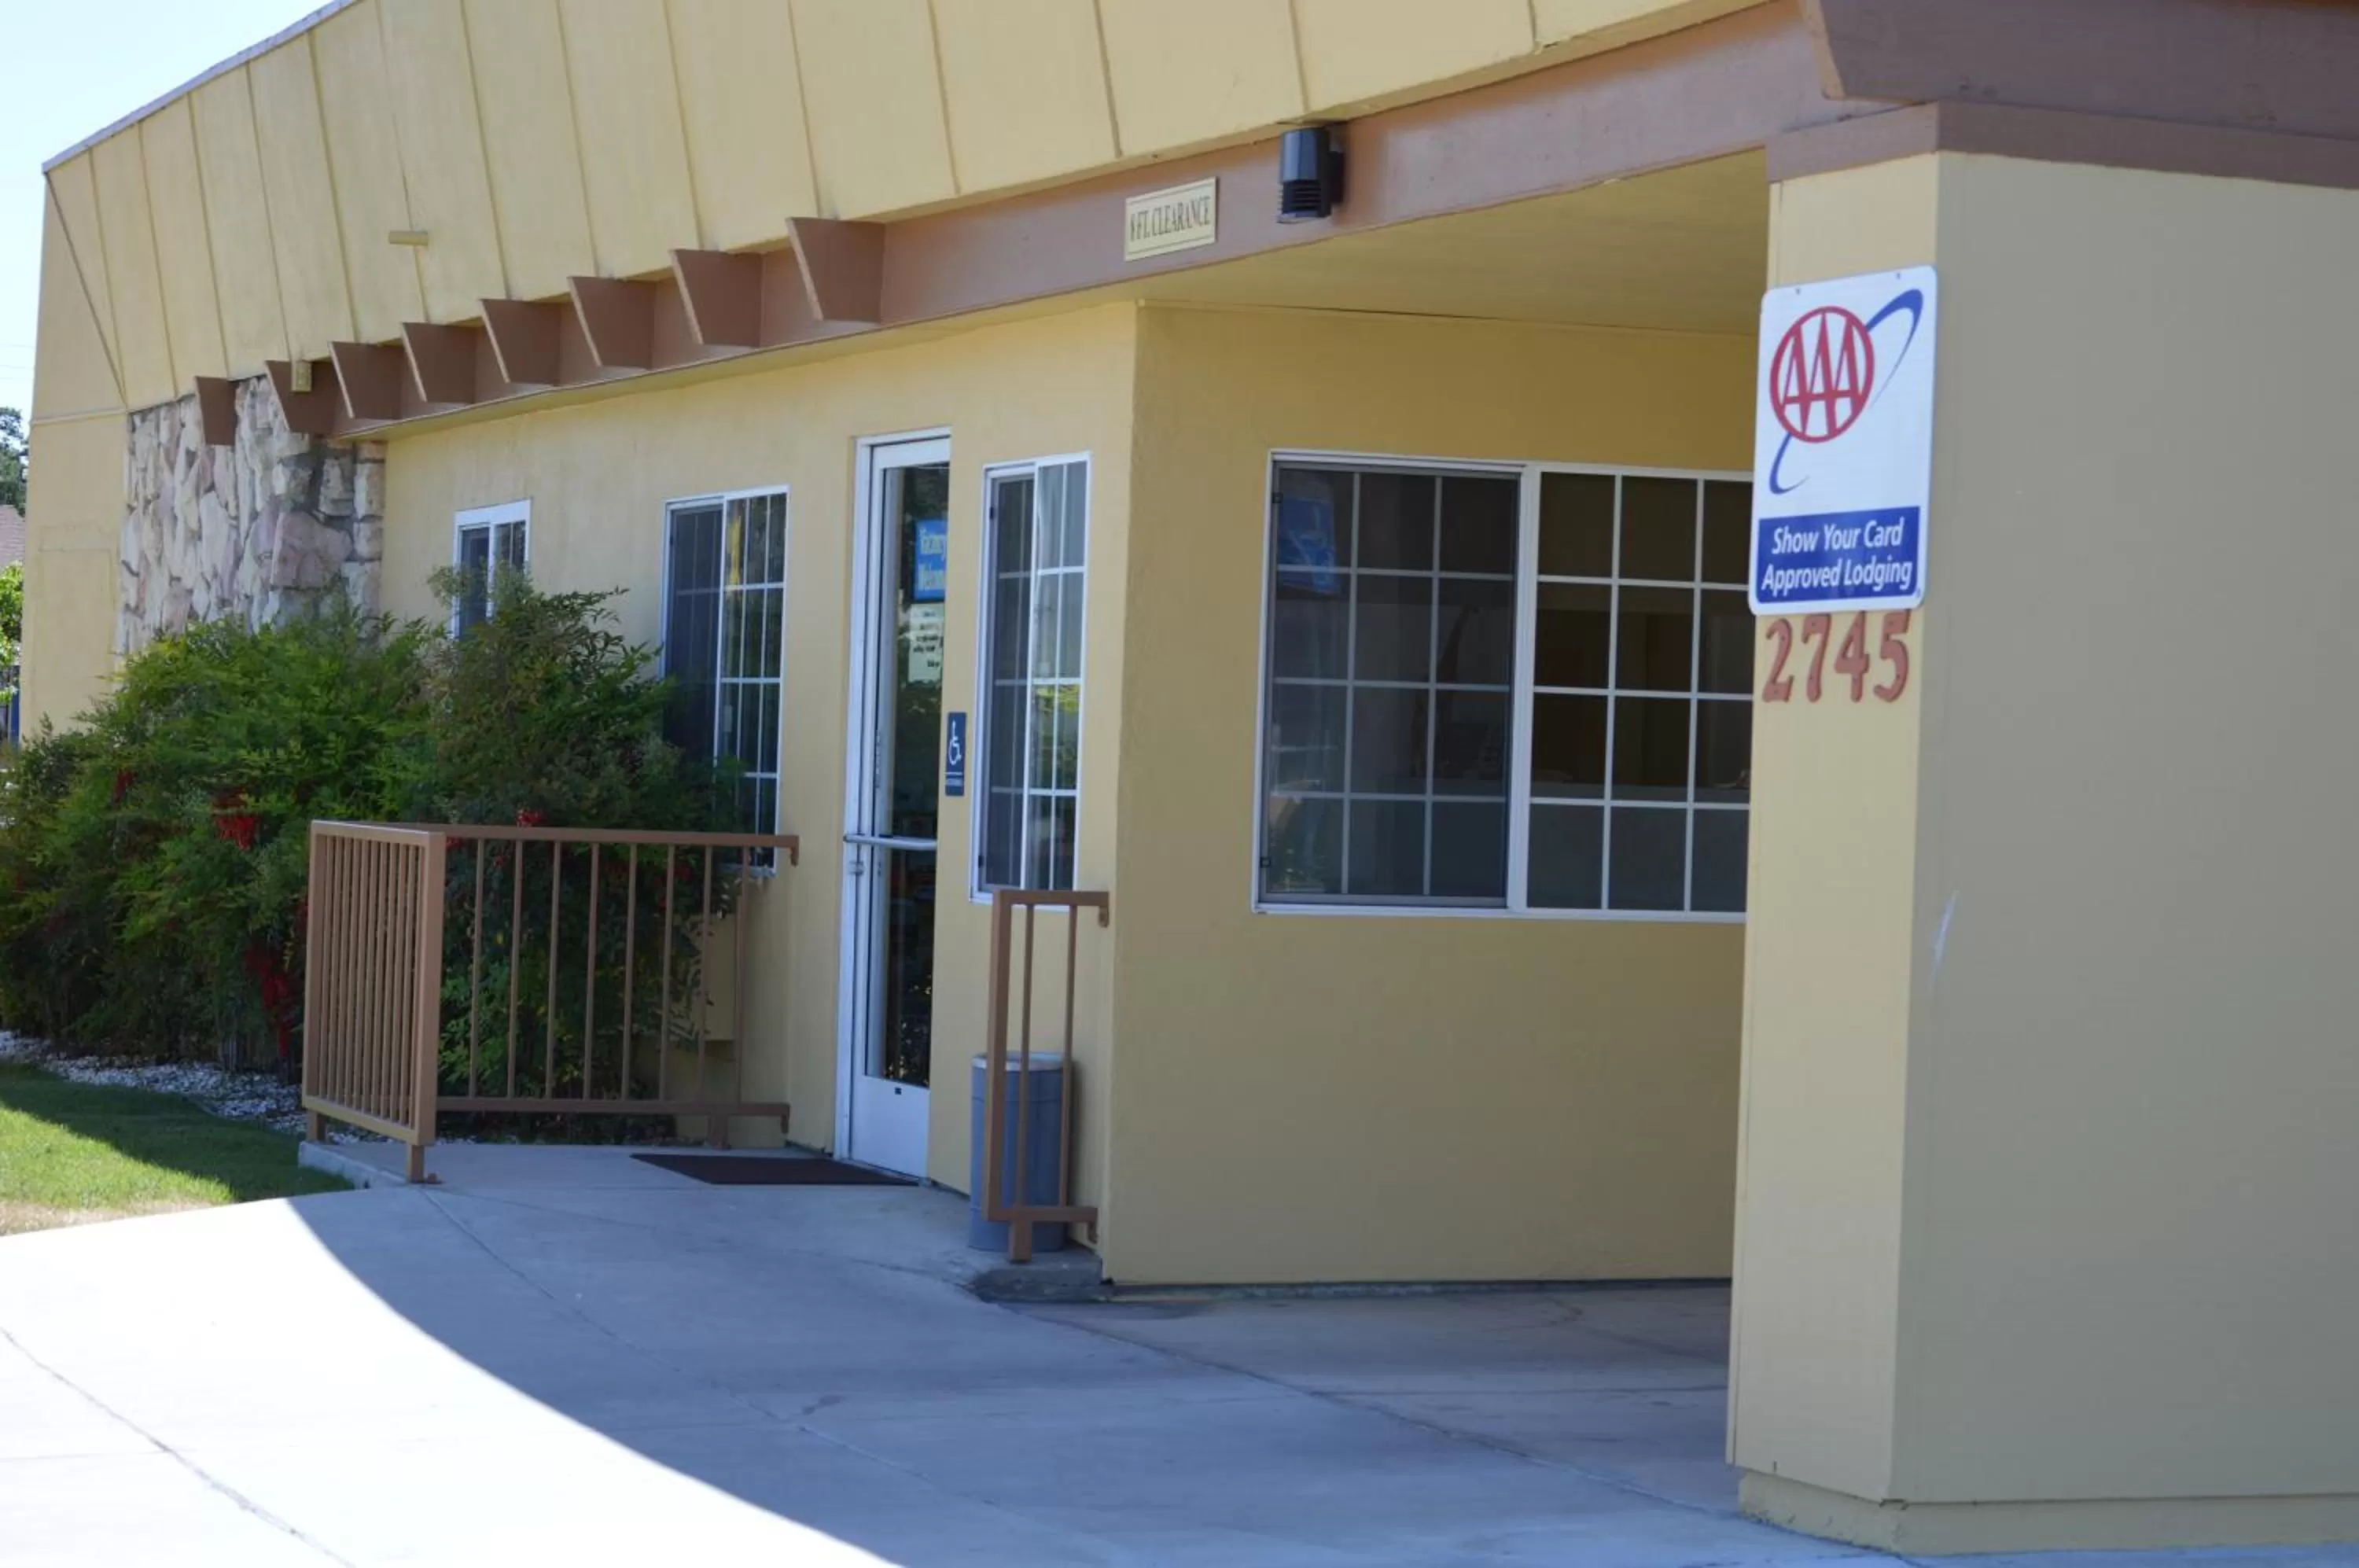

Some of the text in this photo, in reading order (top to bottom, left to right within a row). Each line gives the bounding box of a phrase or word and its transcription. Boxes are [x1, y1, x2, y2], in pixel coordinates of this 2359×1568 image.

[1152, 196, 1211, 237] CLEARANCE
[1772, 307, 1871, 442] AAA
[1772, 517, 1904, 554] Show Your Card
[1761, 554, 1912, 597] Approved Lodging
[1762, 609, 1911, 703] 2745
